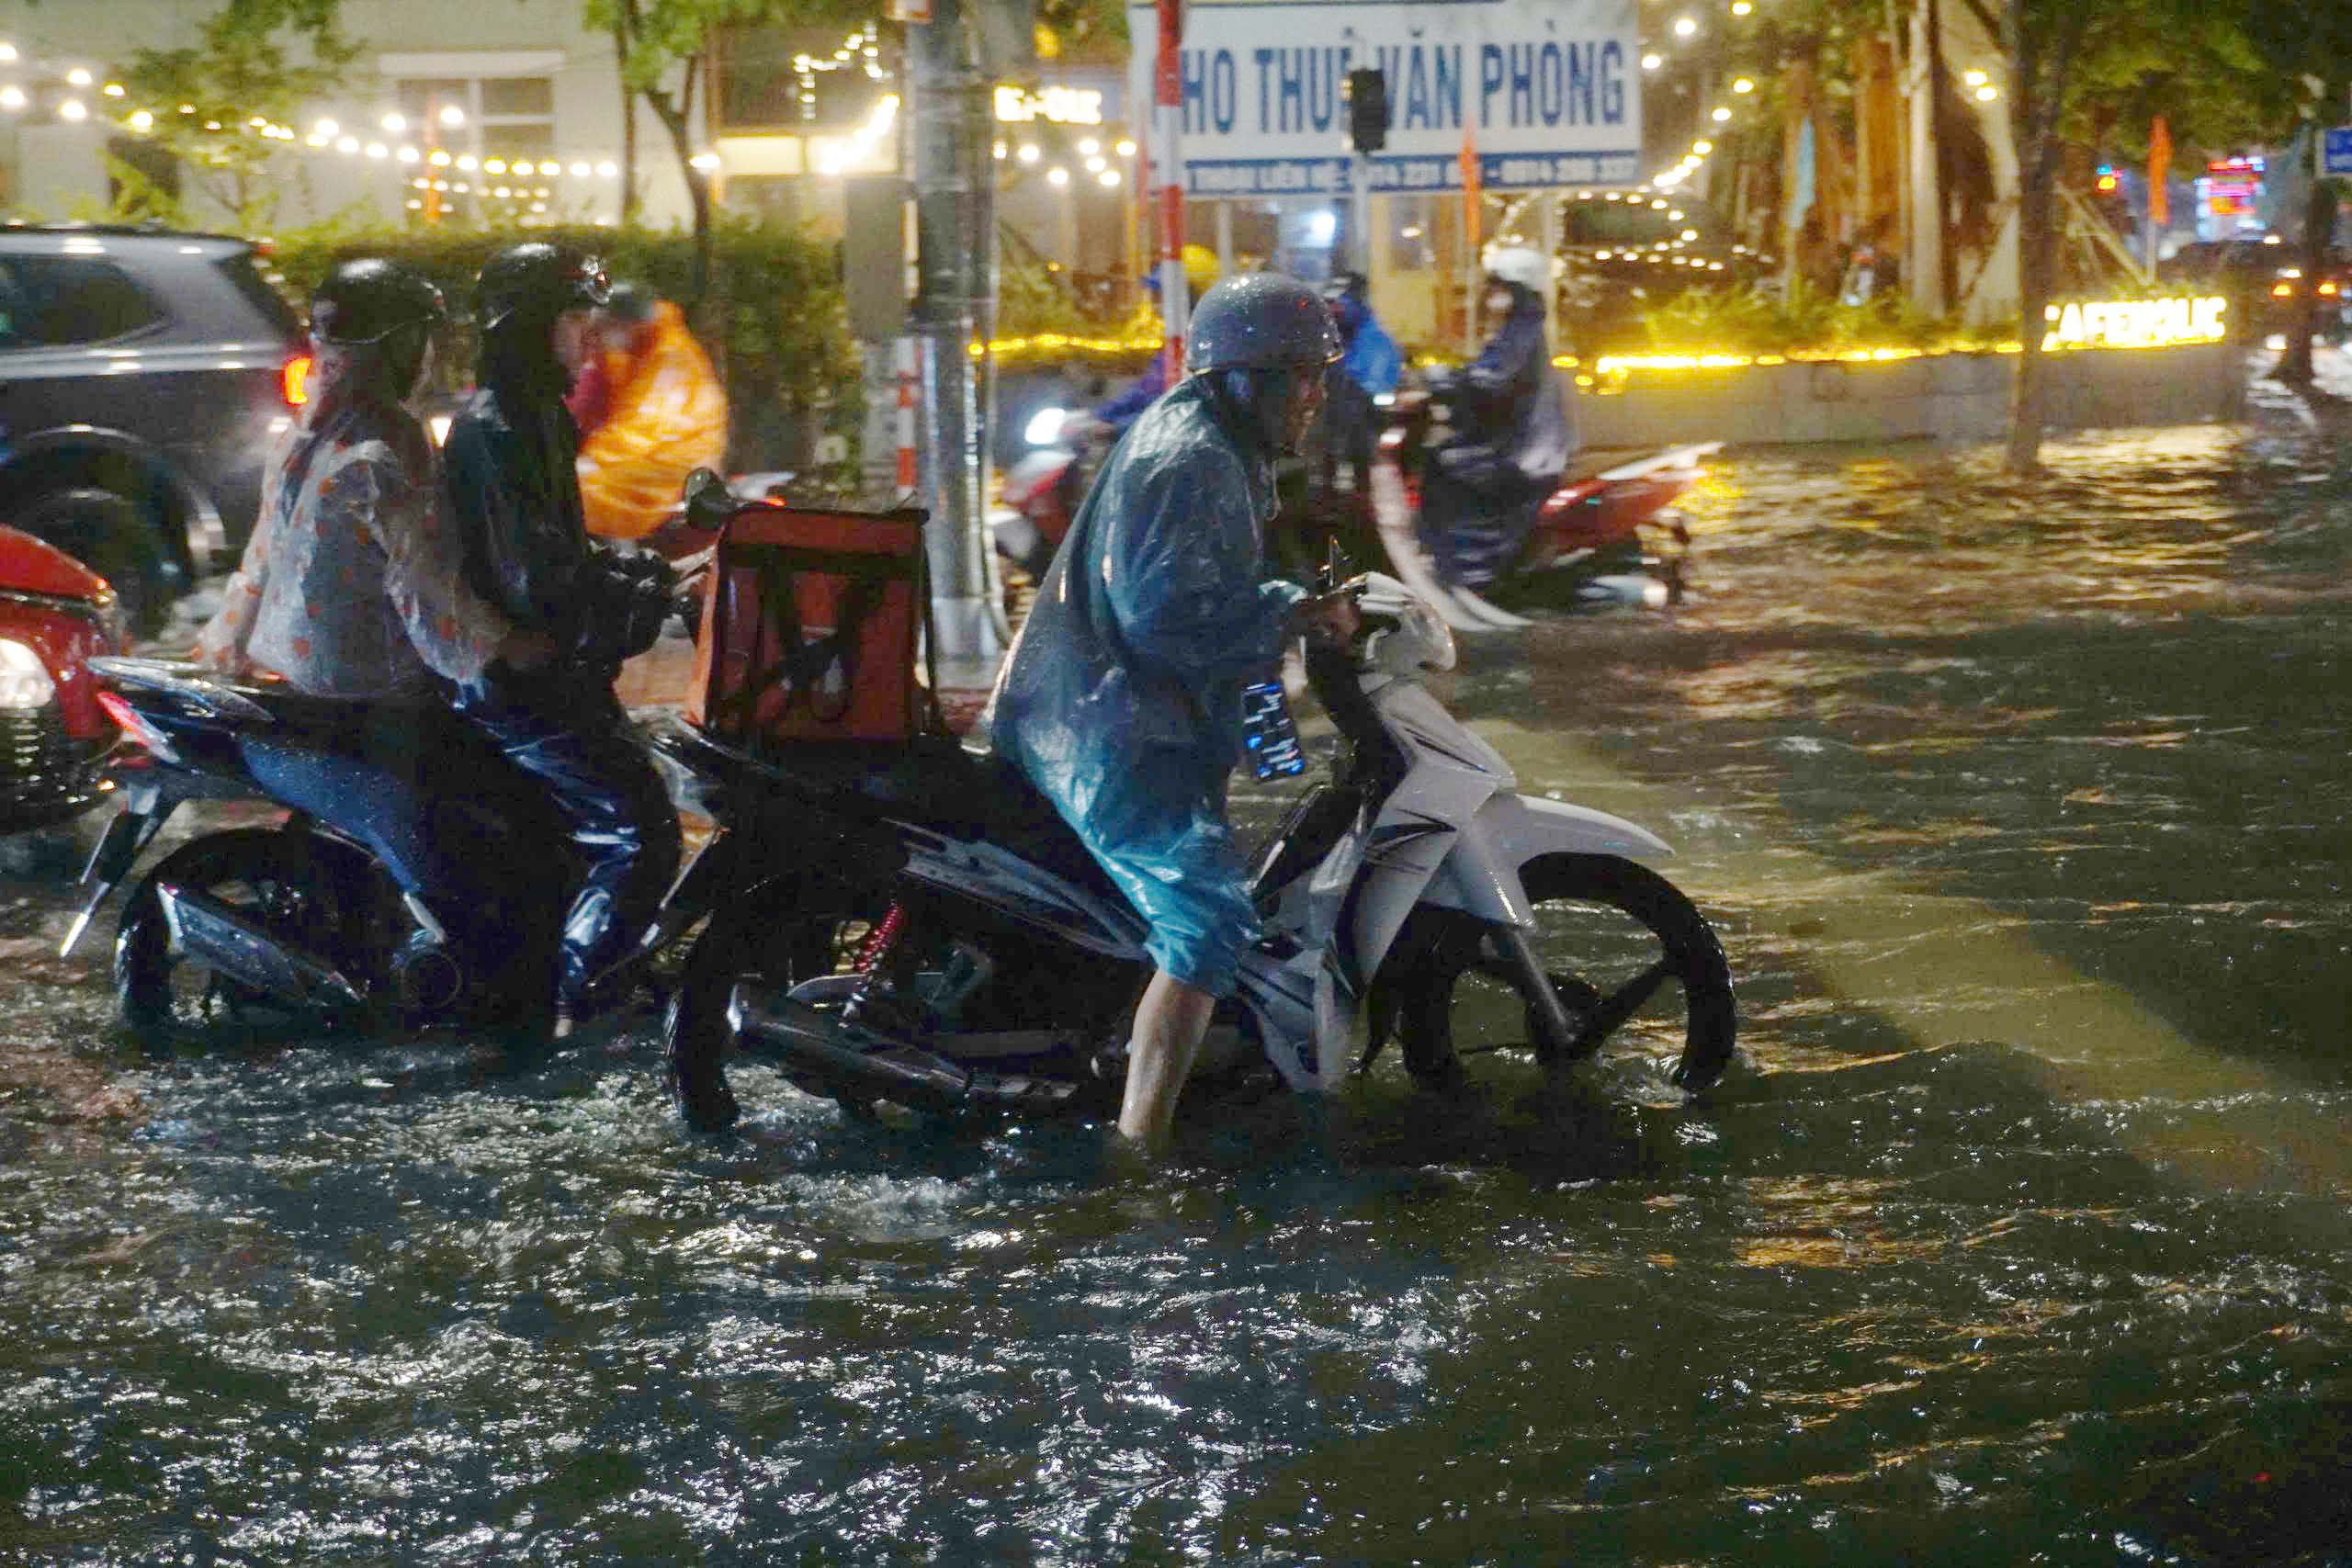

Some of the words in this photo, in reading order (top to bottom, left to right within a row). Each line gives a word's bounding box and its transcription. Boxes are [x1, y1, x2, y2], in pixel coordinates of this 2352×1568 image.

[1152, 48, 1237, 133] HO
[1378, 25, 1462, 130] VĂN
[1480, 18, 1623, 129] PHÒNG
